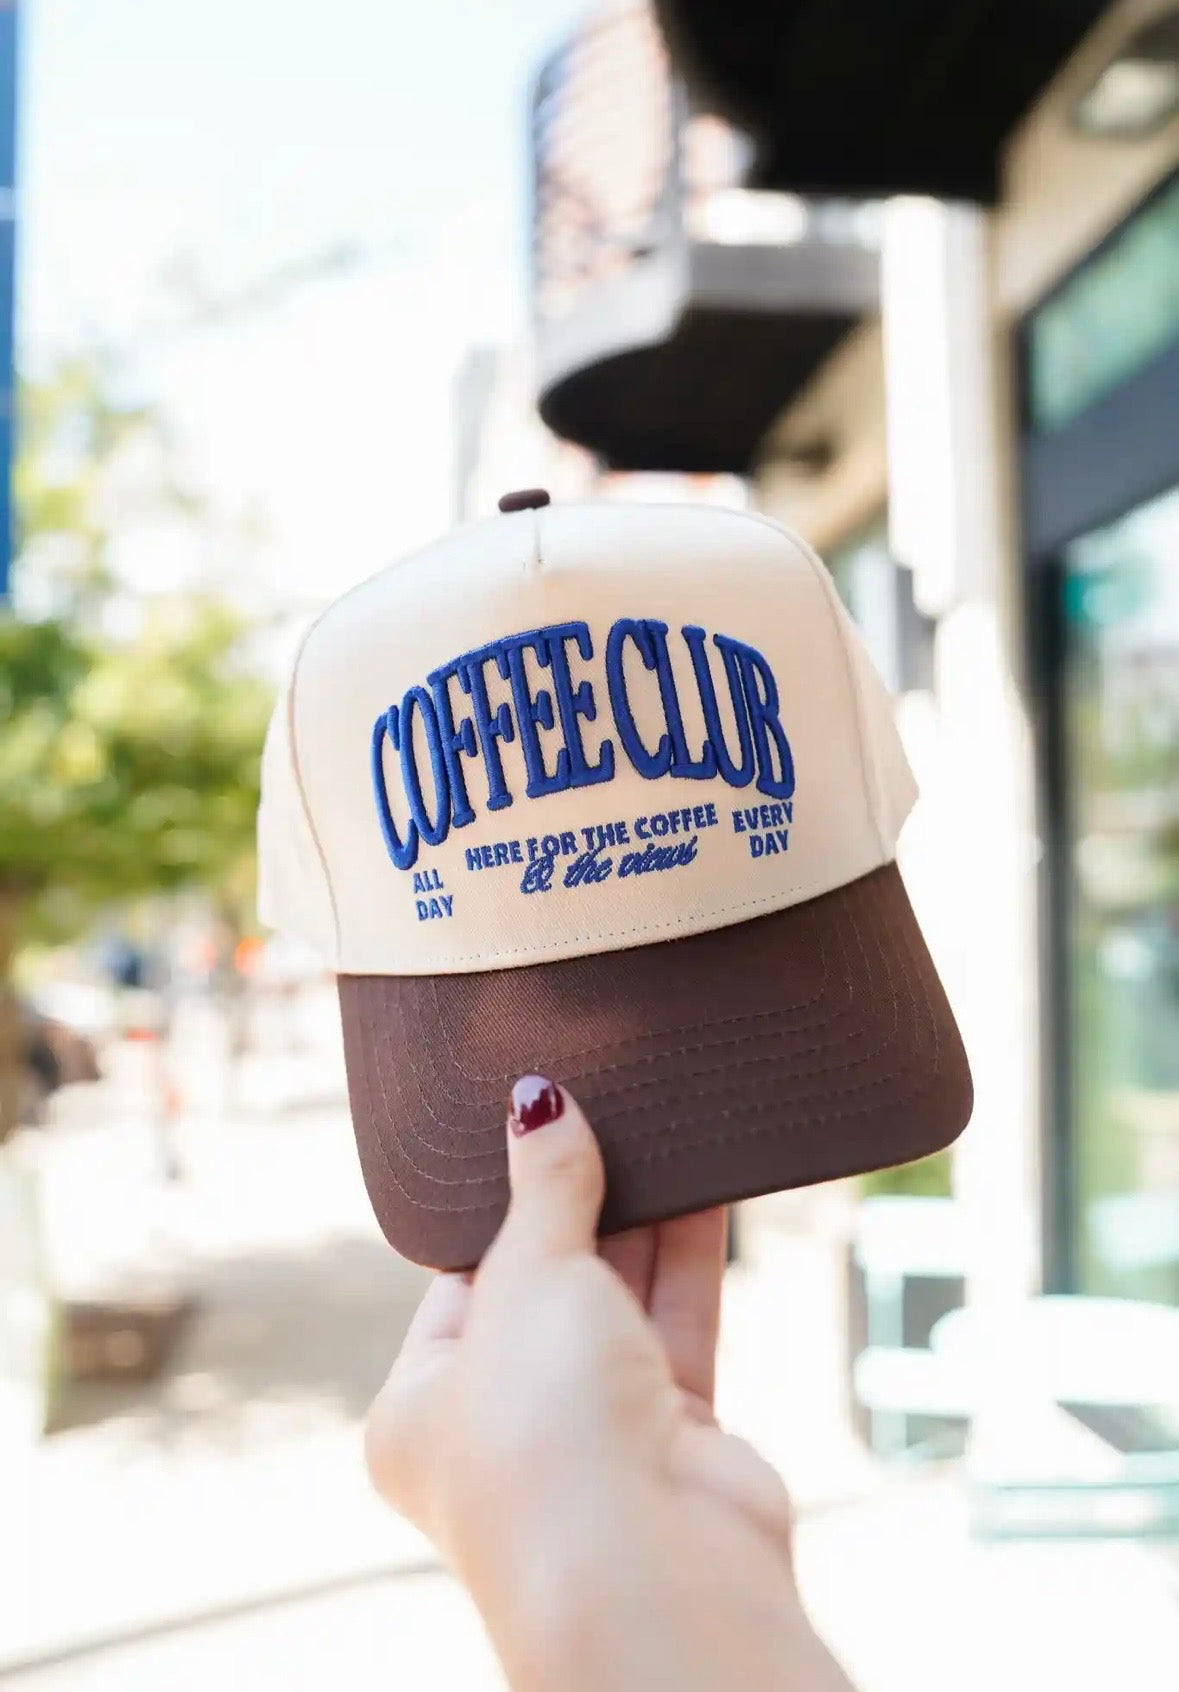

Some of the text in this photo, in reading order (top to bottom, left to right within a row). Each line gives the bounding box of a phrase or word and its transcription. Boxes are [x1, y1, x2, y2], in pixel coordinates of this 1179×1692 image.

[369, 617, 796, 871] COFFEE CLUB
[732, 801, 794, 833] EVERY
[464, 804, 718, 872] HERE FOR THE COFFEE
[749, 831, 789, 859] DAY
[563, 846, 612, 888] the
[617, 836, 698, 878] views
[412, 868, 443, 894] ALL
[415, 895, 453, 921] DAY
